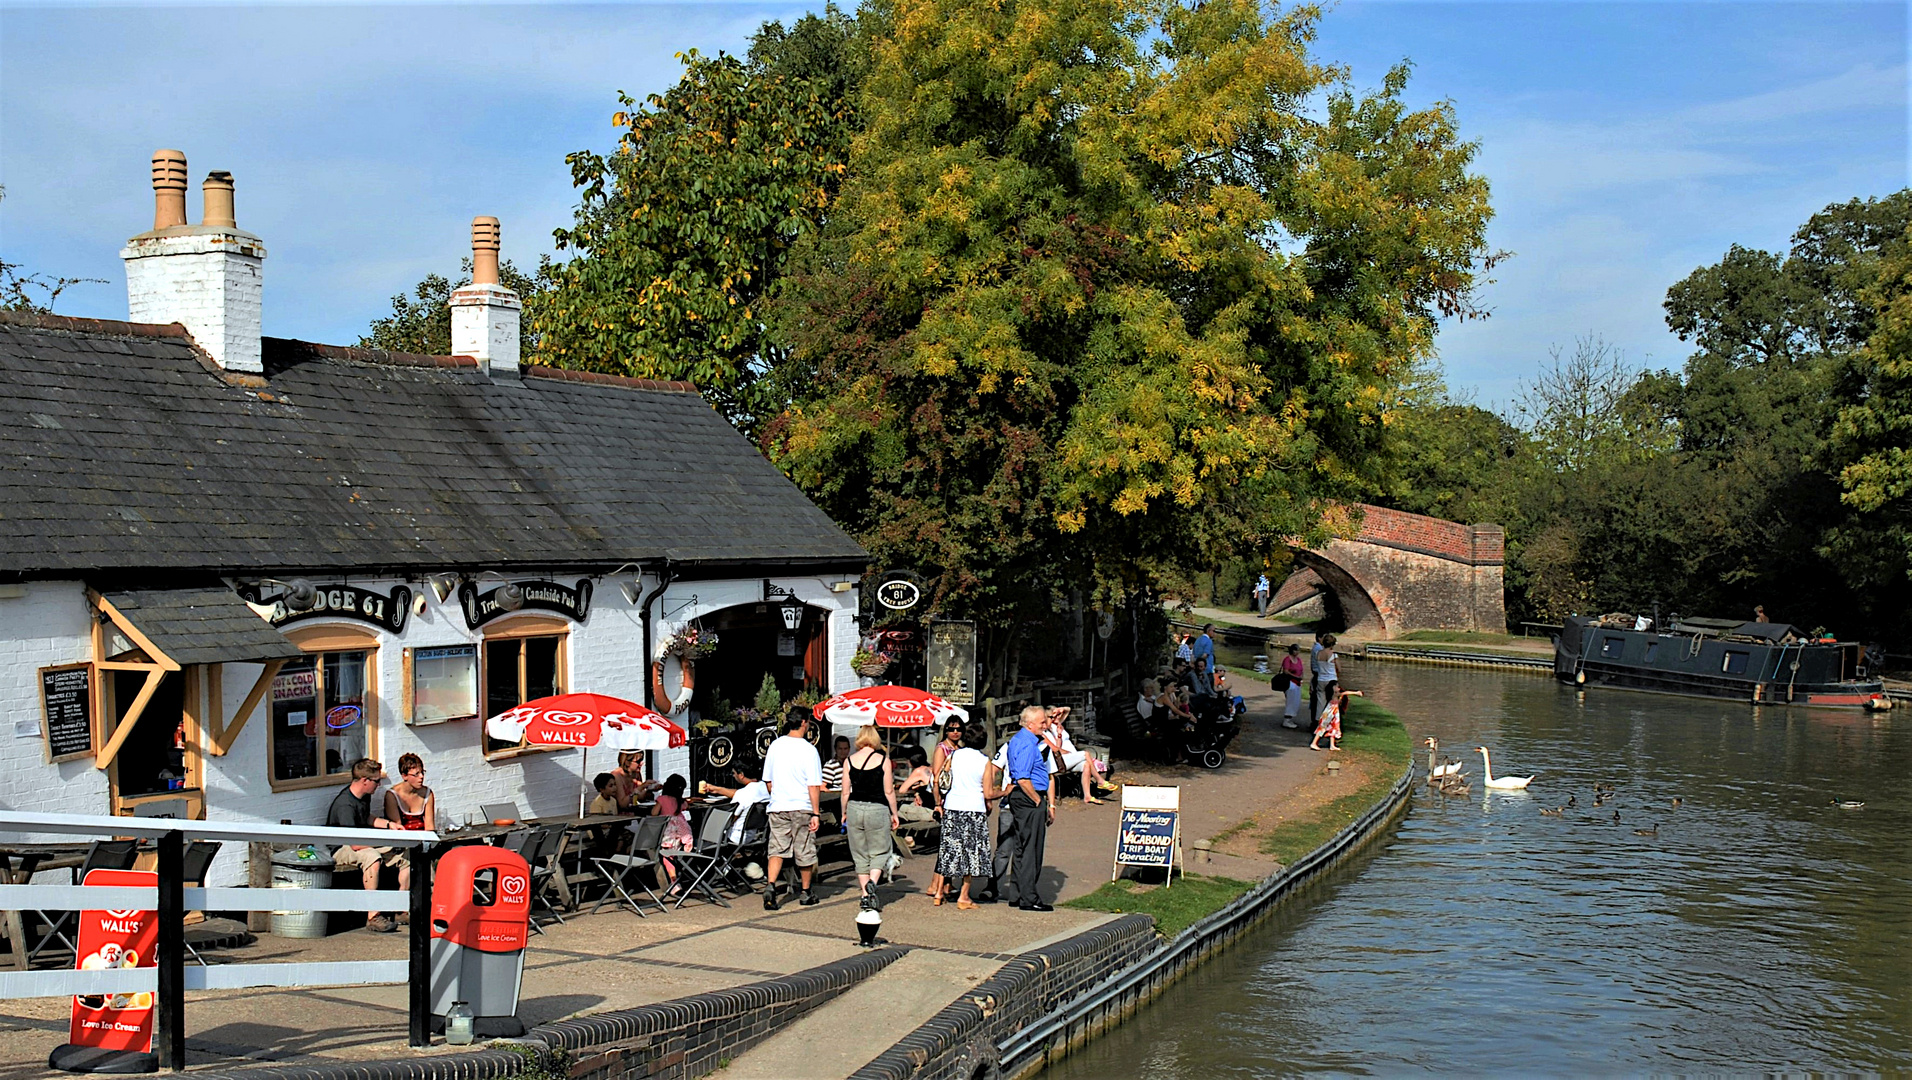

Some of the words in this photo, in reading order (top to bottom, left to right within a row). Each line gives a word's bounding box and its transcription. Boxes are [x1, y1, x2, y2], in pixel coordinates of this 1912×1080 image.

[526, 586, 561, 604] Canalside
[562, 591, 576, 609] Pub
[893, 590, 903, 599] 61
[272, 590, 357, 622] BDGE
[363, 595, 384, 621] 61
[292, 675, 313, 685] COLD
[274, 686, 312, 698] SNACKS
[888, 715, 924, 723] WALL'S
[541, 731, 586, 743] WALL'S
[1123, 812, 1136, 822] No
[1137, 812, 1171, 825] Mooring
[1122, 830, 1171, 845] VAGABOND
[1145, 846, 1167, 854] BOAT
[1119, 852, 1167, 864] Operating
[101, 919, 140, 933] WALL'S
[82, 1019, 100, 1029] Love
[101, 1021, 113, 1031] Ice
[114, 1021, 141, 1032] Cream
